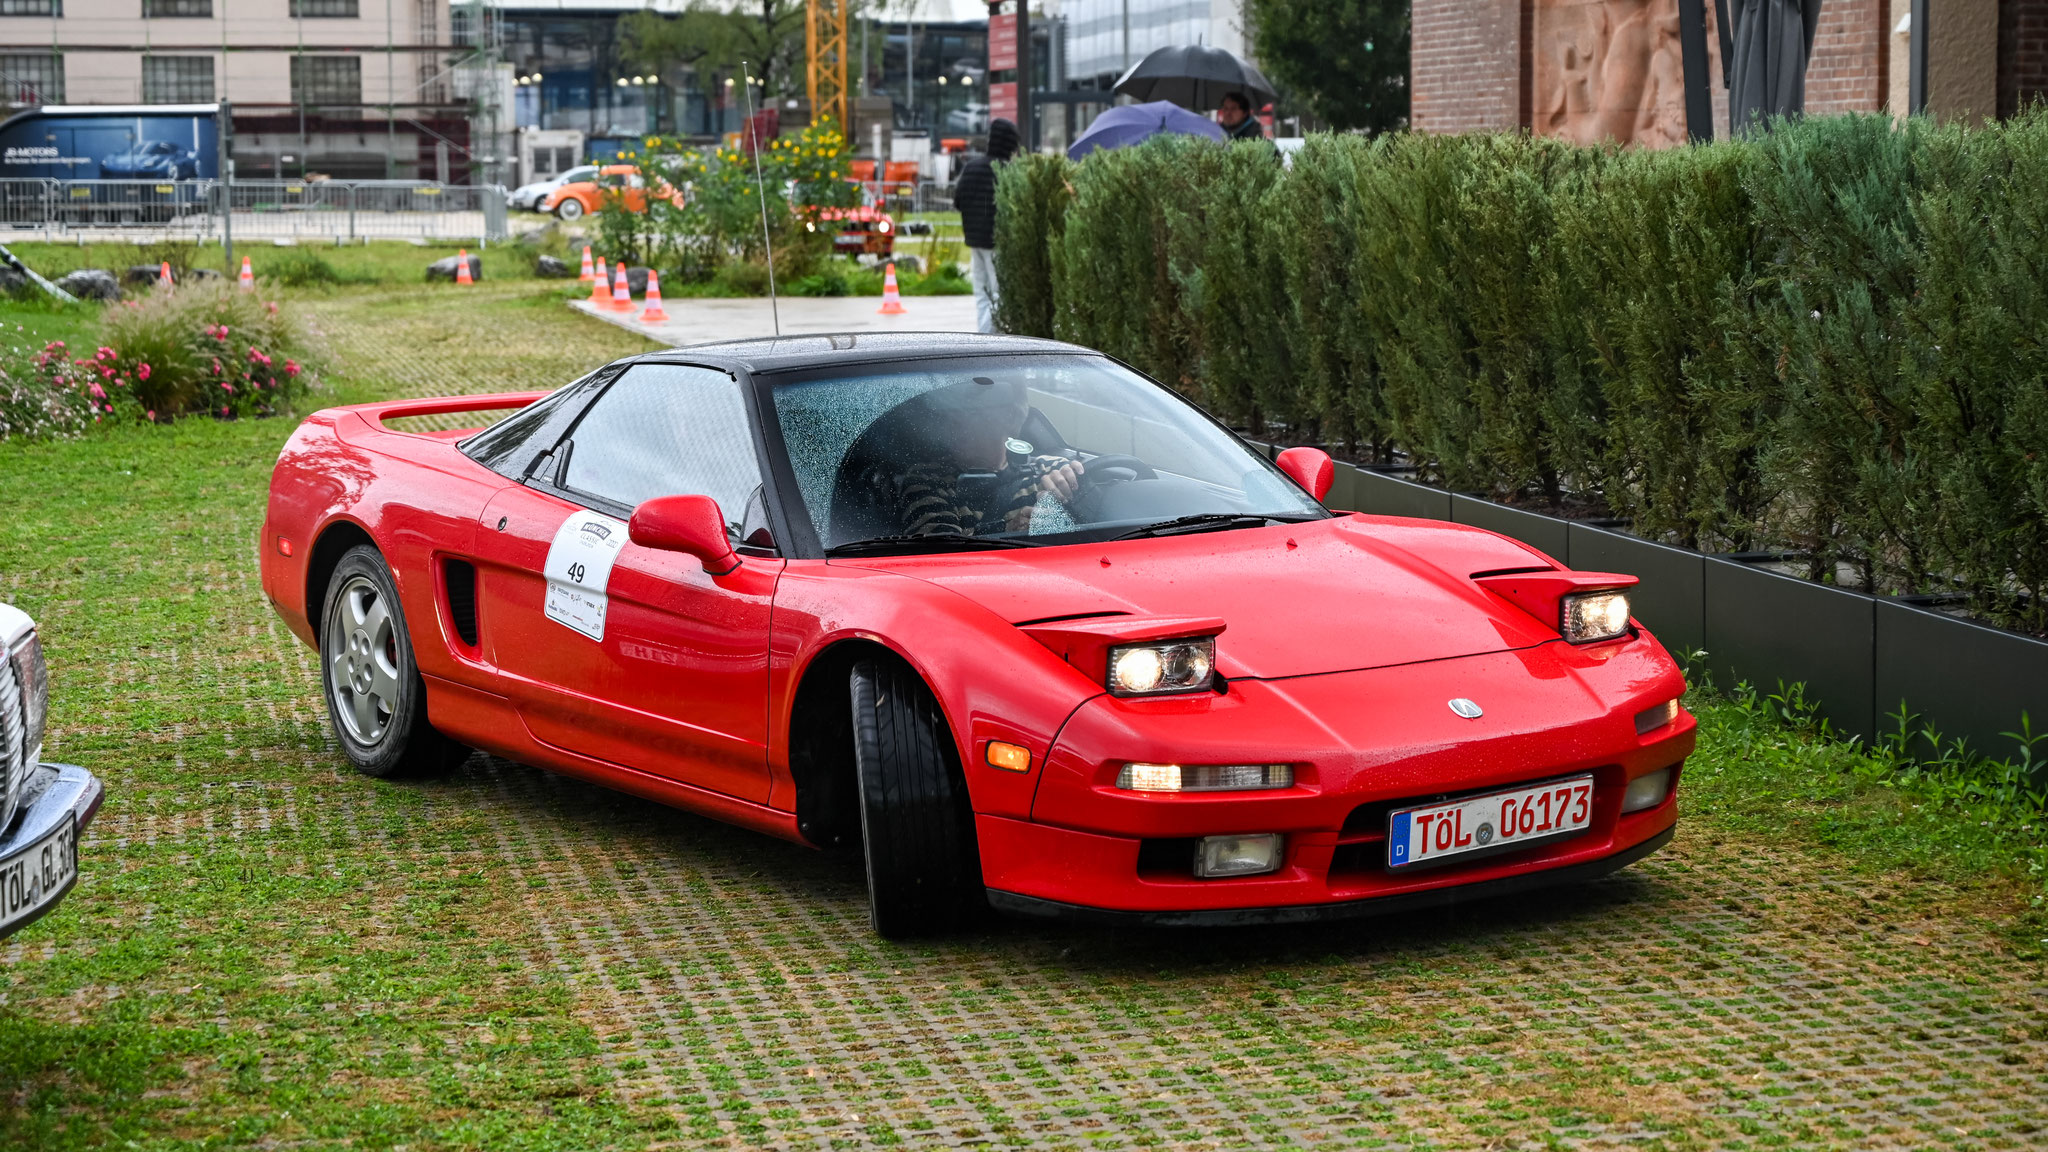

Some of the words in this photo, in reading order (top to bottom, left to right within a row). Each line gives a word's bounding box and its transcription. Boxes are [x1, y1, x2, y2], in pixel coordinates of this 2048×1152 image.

[567, 562, 585, 583] 49
[1416, 808, 1472, 855] TÖL
[1500, 784, 1591, 838] 06173
[1396, 845, 1404, 857] D
[0, 859, 31, 919] TÖL
[42, 843, 57, 894] GL
